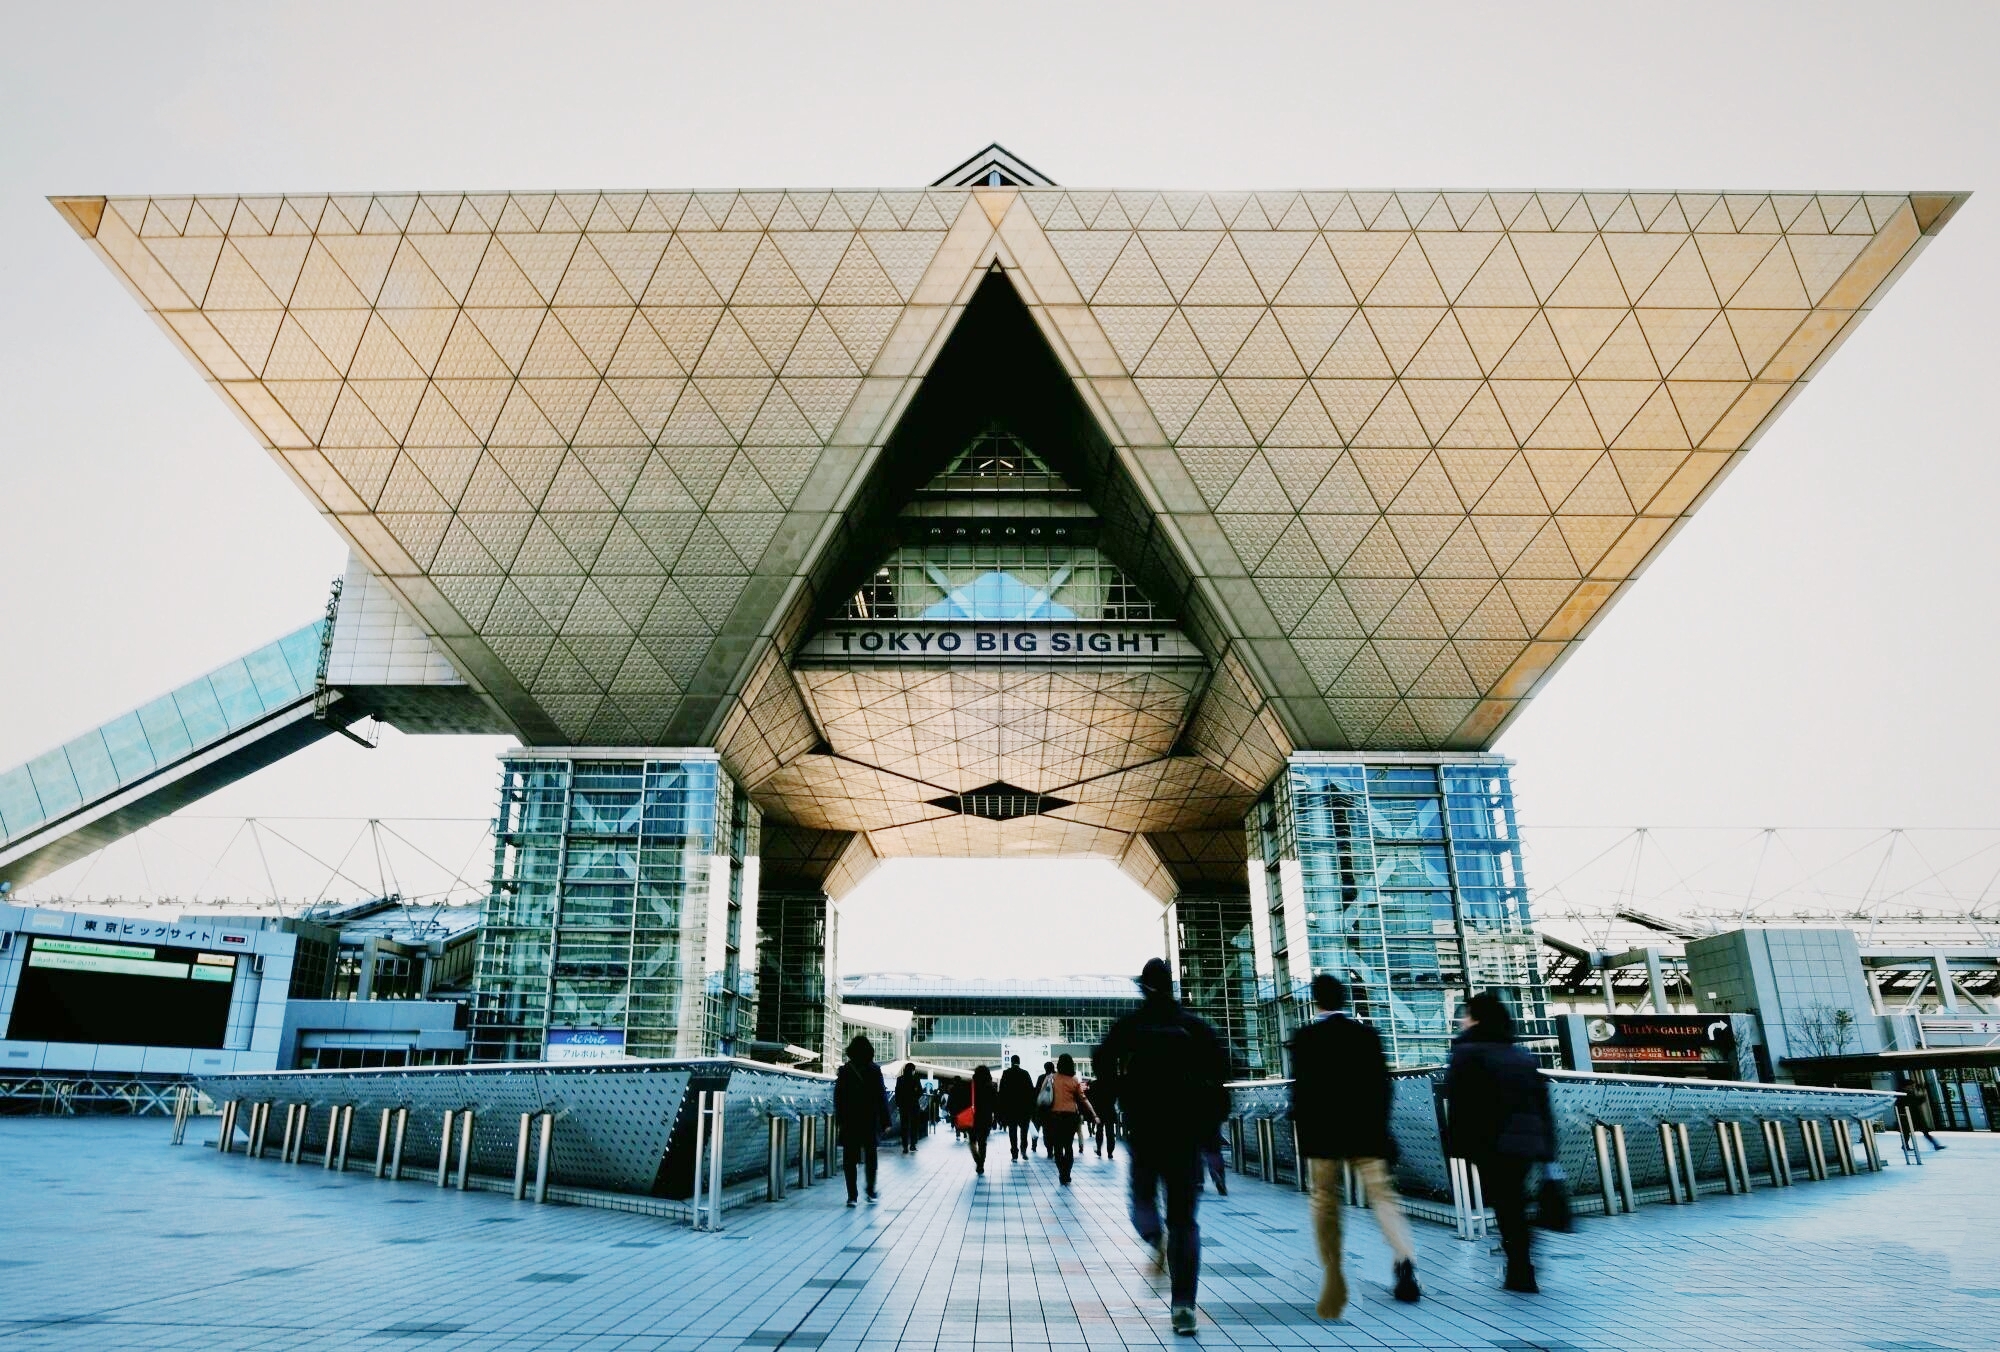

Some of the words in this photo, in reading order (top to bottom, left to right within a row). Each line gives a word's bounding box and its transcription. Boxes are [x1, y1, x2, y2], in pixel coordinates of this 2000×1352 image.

[835, 632, 962, 651] TOKYO
[976, 632, 1037, 652] BIG
[1051, 632, 1166, 652] SIGHT
[84, 920, 211, 942] 東京ビッグサイト
[1660, 1025, 1704, 1035] GALLERY
